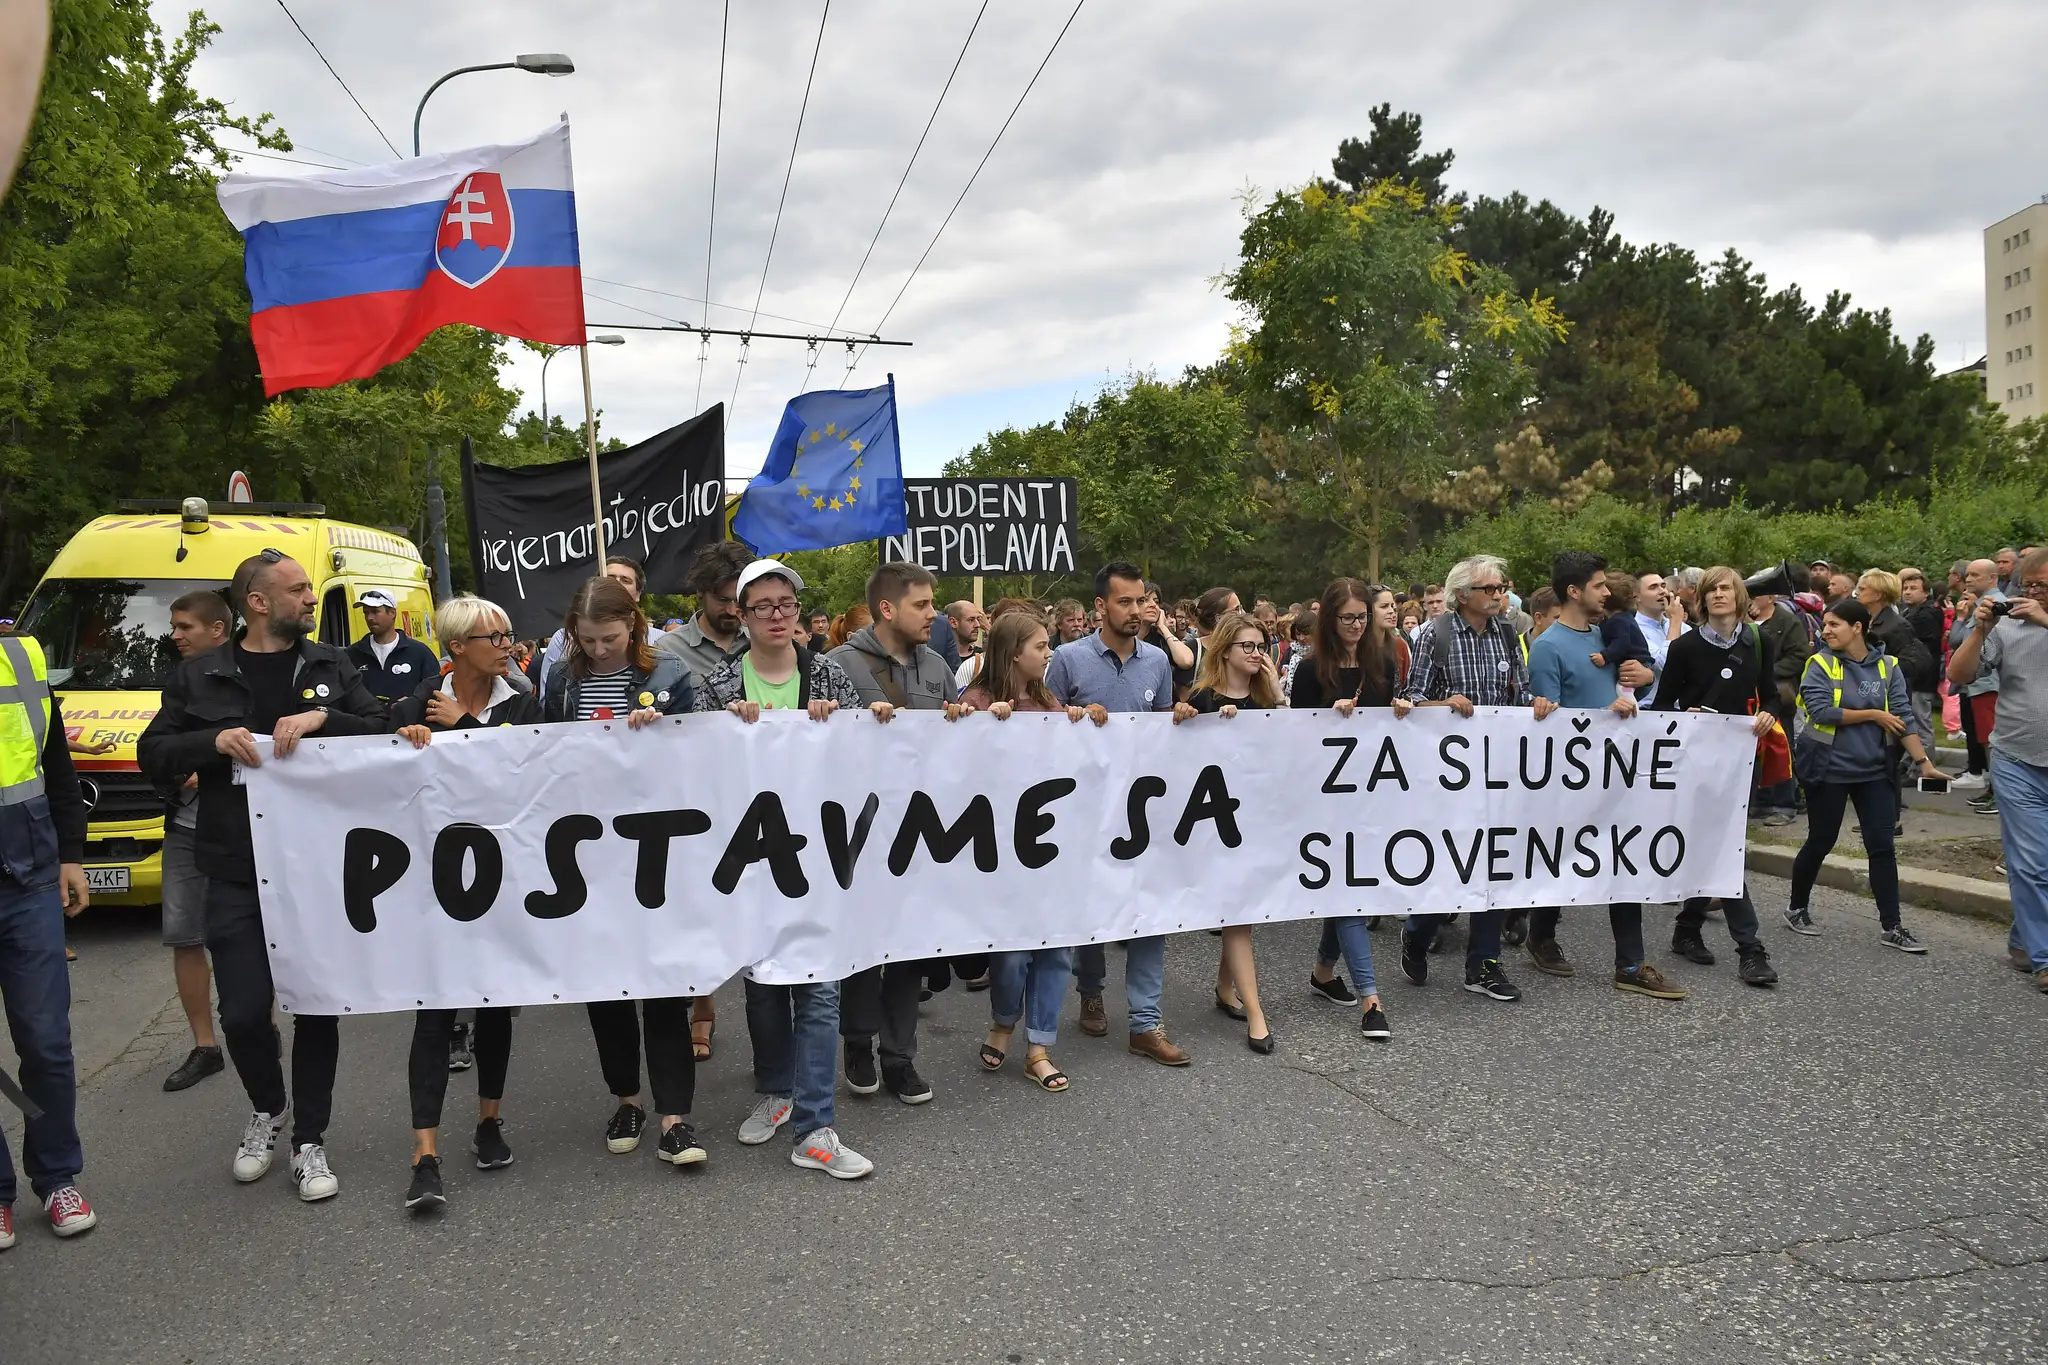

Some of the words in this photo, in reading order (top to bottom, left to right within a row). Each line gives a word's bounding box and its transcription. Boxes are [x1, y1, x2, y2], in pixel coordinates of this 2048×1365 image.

[903, 482, 1067, 523] TUDENTI
[1321, 735, 1410, 793] ZA
[1439, 717, 1682, 790] SLUŠNÉ
[343, 777, 1077, 934] POSTAVME
[1109, 764, 1243, 861] SA
[1299, 824, 1686, 890] SLOVENSKO
